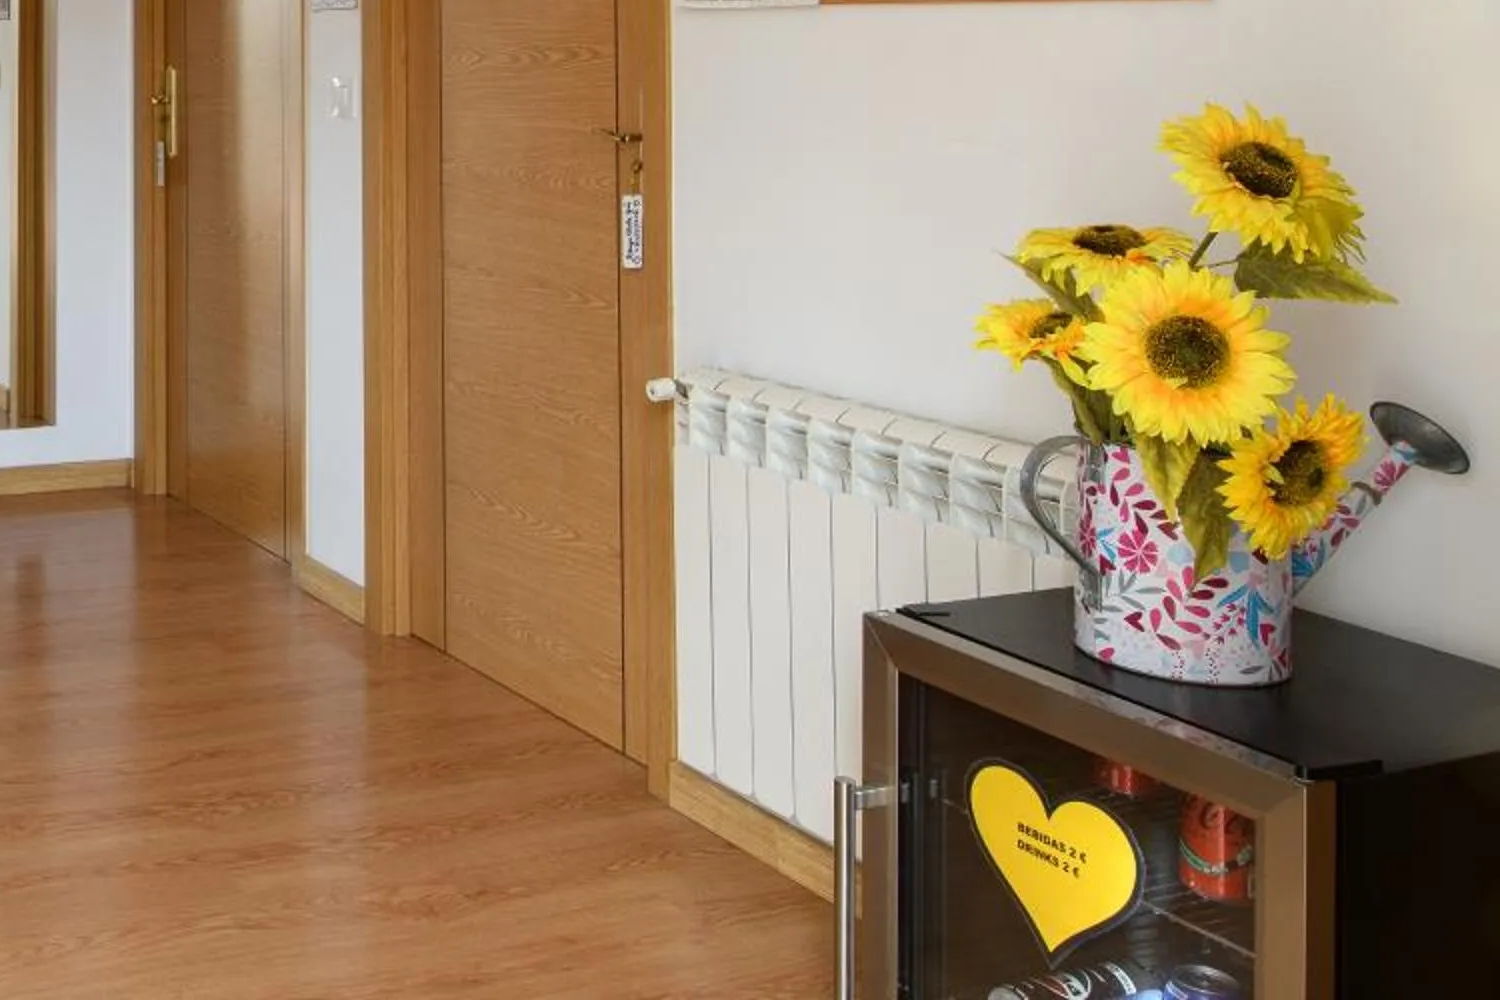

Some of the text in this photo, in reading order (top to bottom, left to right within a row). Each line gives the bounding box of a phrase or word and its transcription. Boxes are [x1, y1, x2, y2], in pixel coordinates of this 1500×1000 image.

[1017, 821, 1067, 853] BEBIDAS
[1068, 846, 1077, 859] 2
[1017, 839, 1060, 868] DRINKS
[1062, 861, 1070, 873] 2
